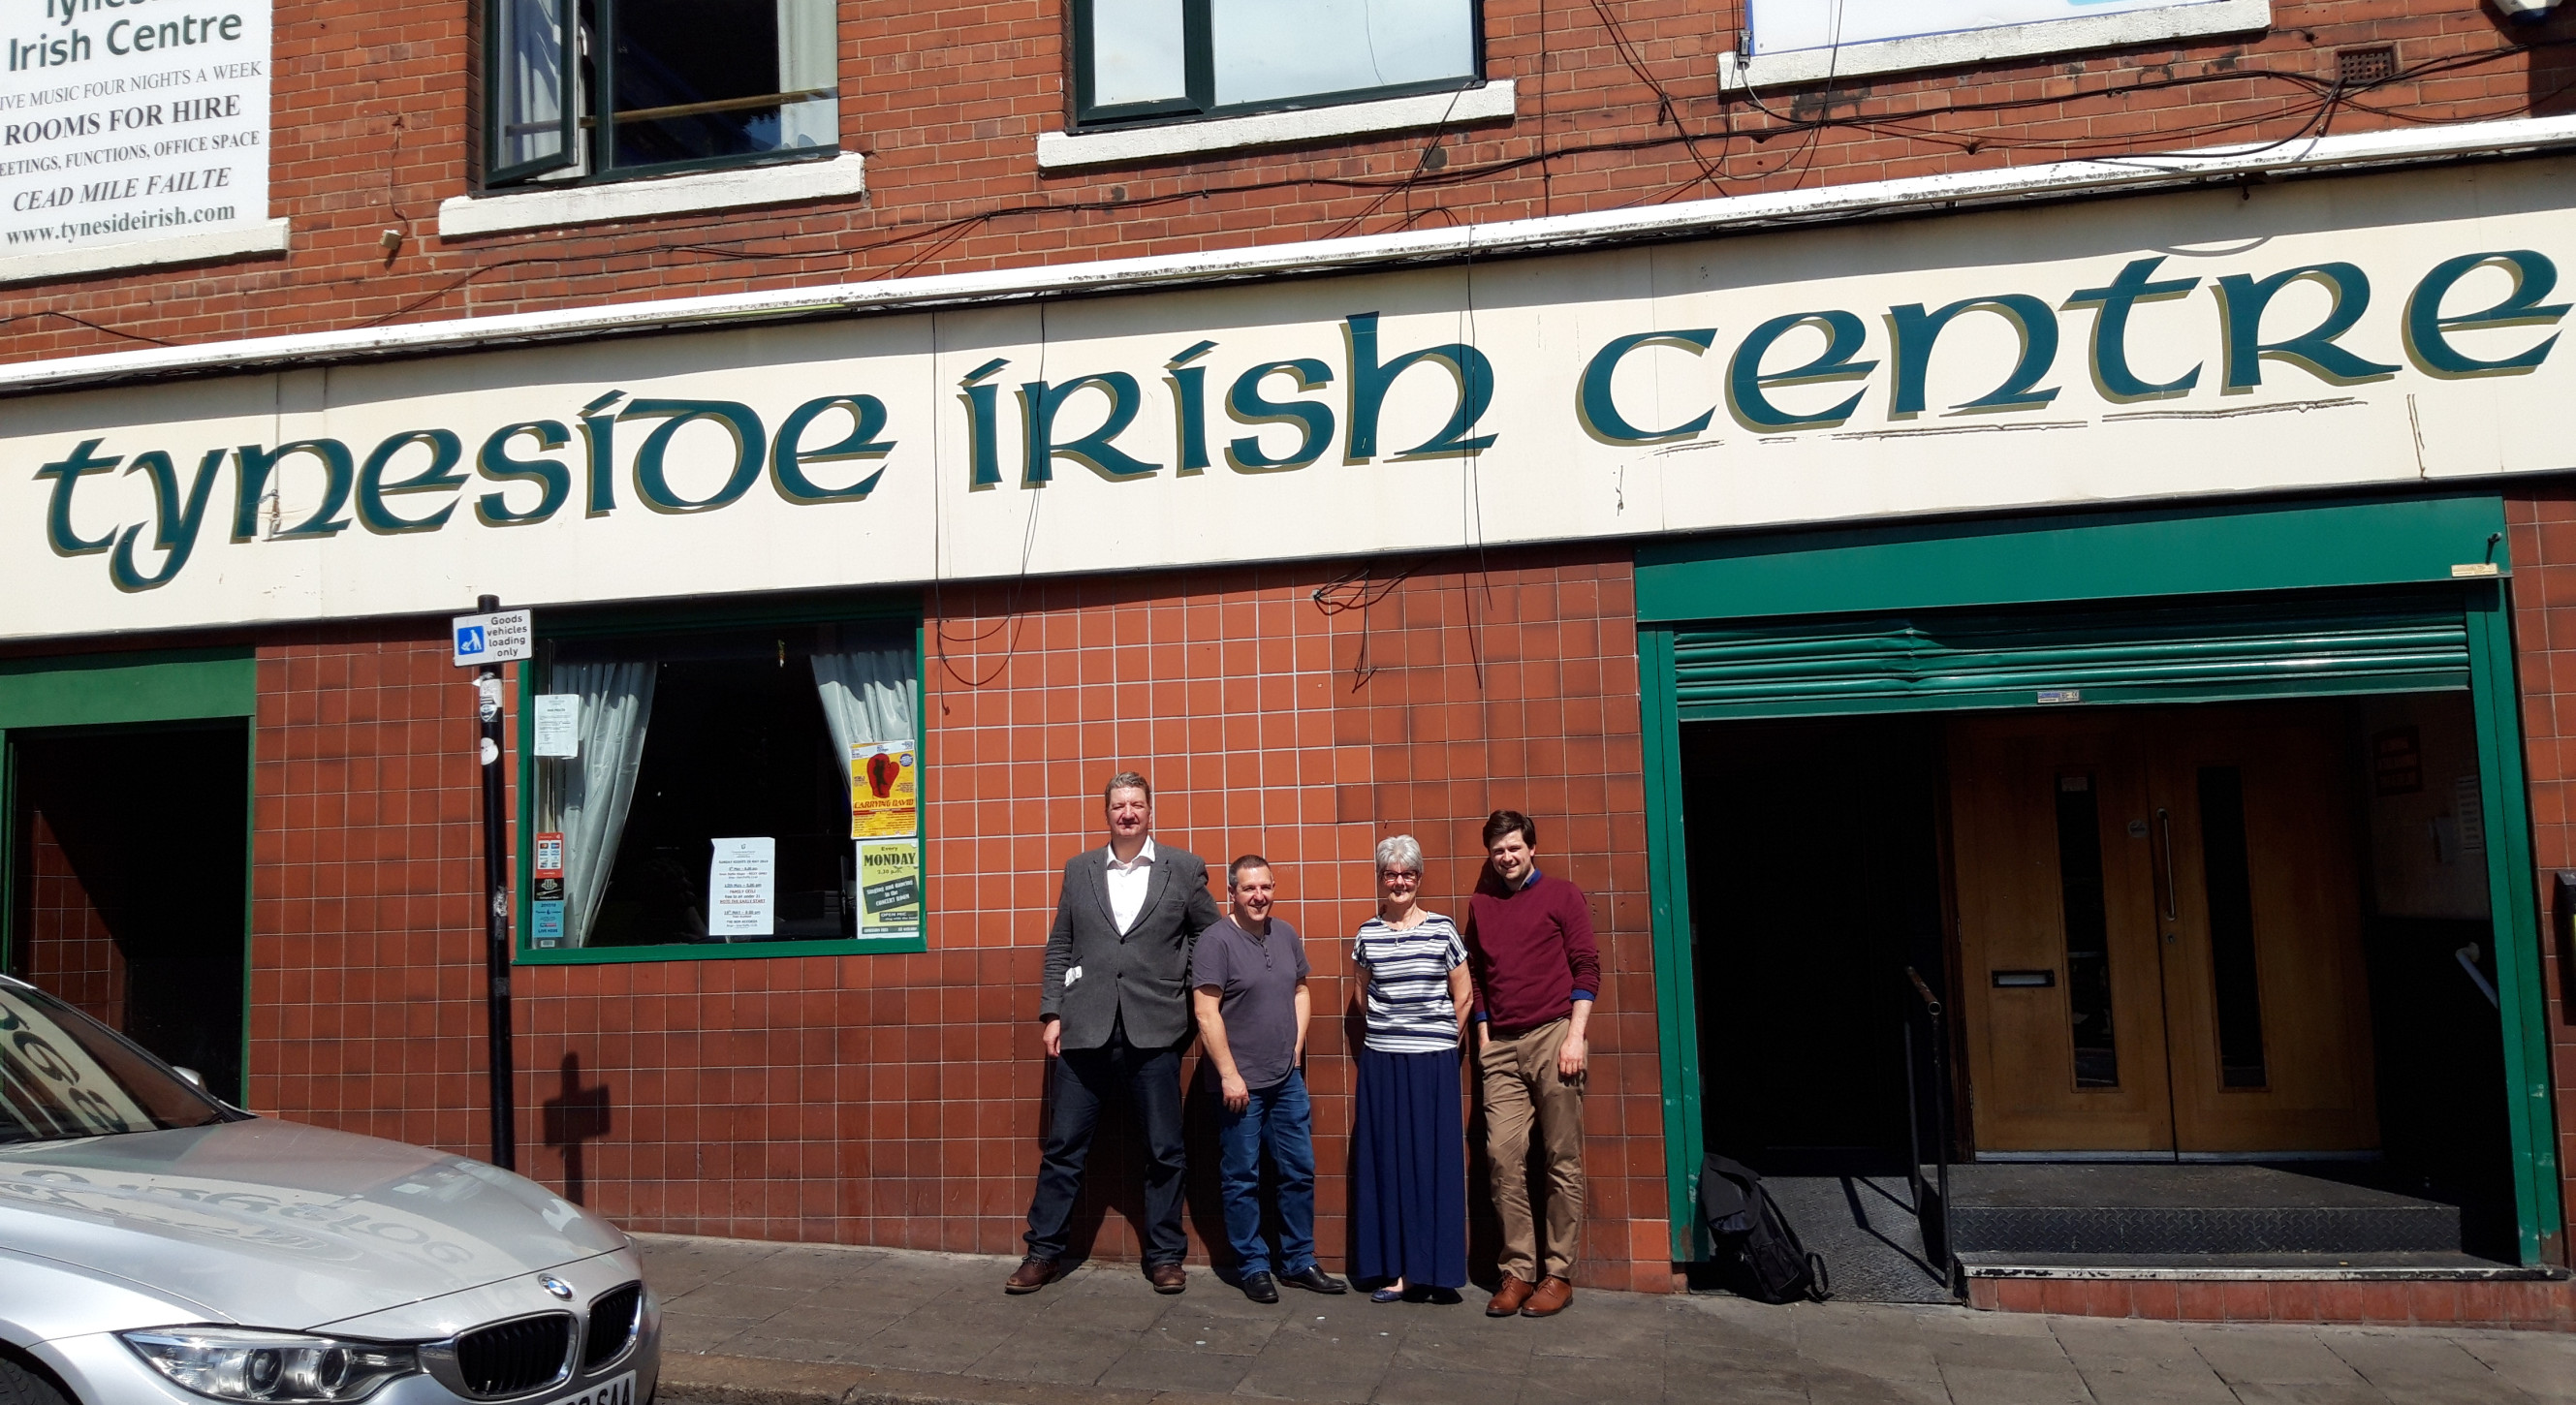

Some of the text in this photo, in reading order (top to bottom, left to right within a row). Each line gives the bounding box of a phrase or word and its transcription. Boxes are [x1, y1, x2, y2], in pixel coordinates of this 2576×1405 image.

[9, 14, 242, 72] Irish Centre
[29, 85, 79, 108] MUSIC
[83, 78, 125, 99] FOUR
[130, 69, 191, 92] NIGHTS
[196, 69, 207, 82] A
[213, 60, 263, 80] WEEK
[4, 94, 241, 146] ROOMS FOR HIRE
[66, 144, 151, 170] FUNCTIONS,
[154, 137, 207, 157] OFFICE
[211, 130, 260, 150] SPACE
[13, 167, 233, 212] CEAD MILE FAILTE
[6, 204, 236, 244] www.tynesideirish.com
[487, 626, 527, 637] vehicles
[490, 614, 523, 625] Goods
[488, 637, 526, 647] loading
[497, 647, 518, 657] only
[864, 853, 916, 866] MONDAY
